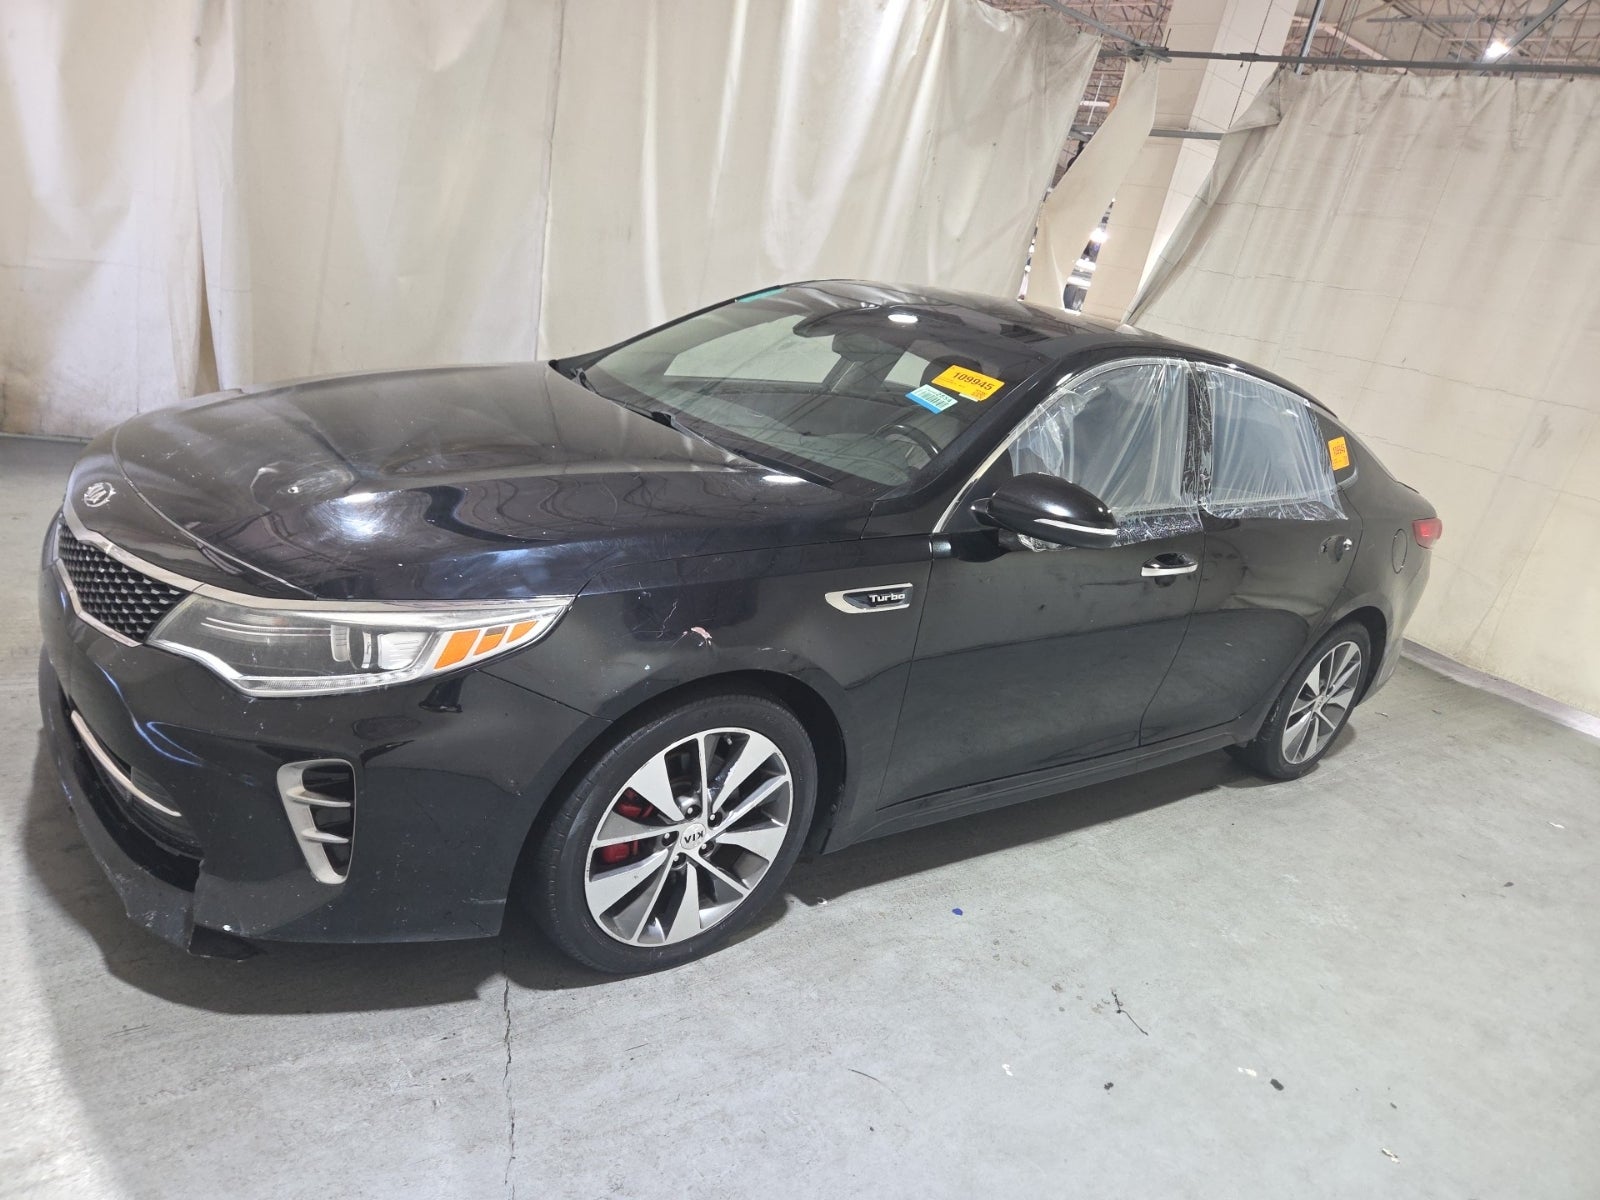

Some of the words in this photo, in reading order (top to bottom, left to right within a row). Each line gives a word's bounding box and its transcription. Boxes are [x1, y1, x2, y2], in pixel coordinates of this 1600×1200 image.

[953, 371, 995, 391] 109945
[868, 592, 906, 603] Turbo
[684, 830, 703, 844] KIA
